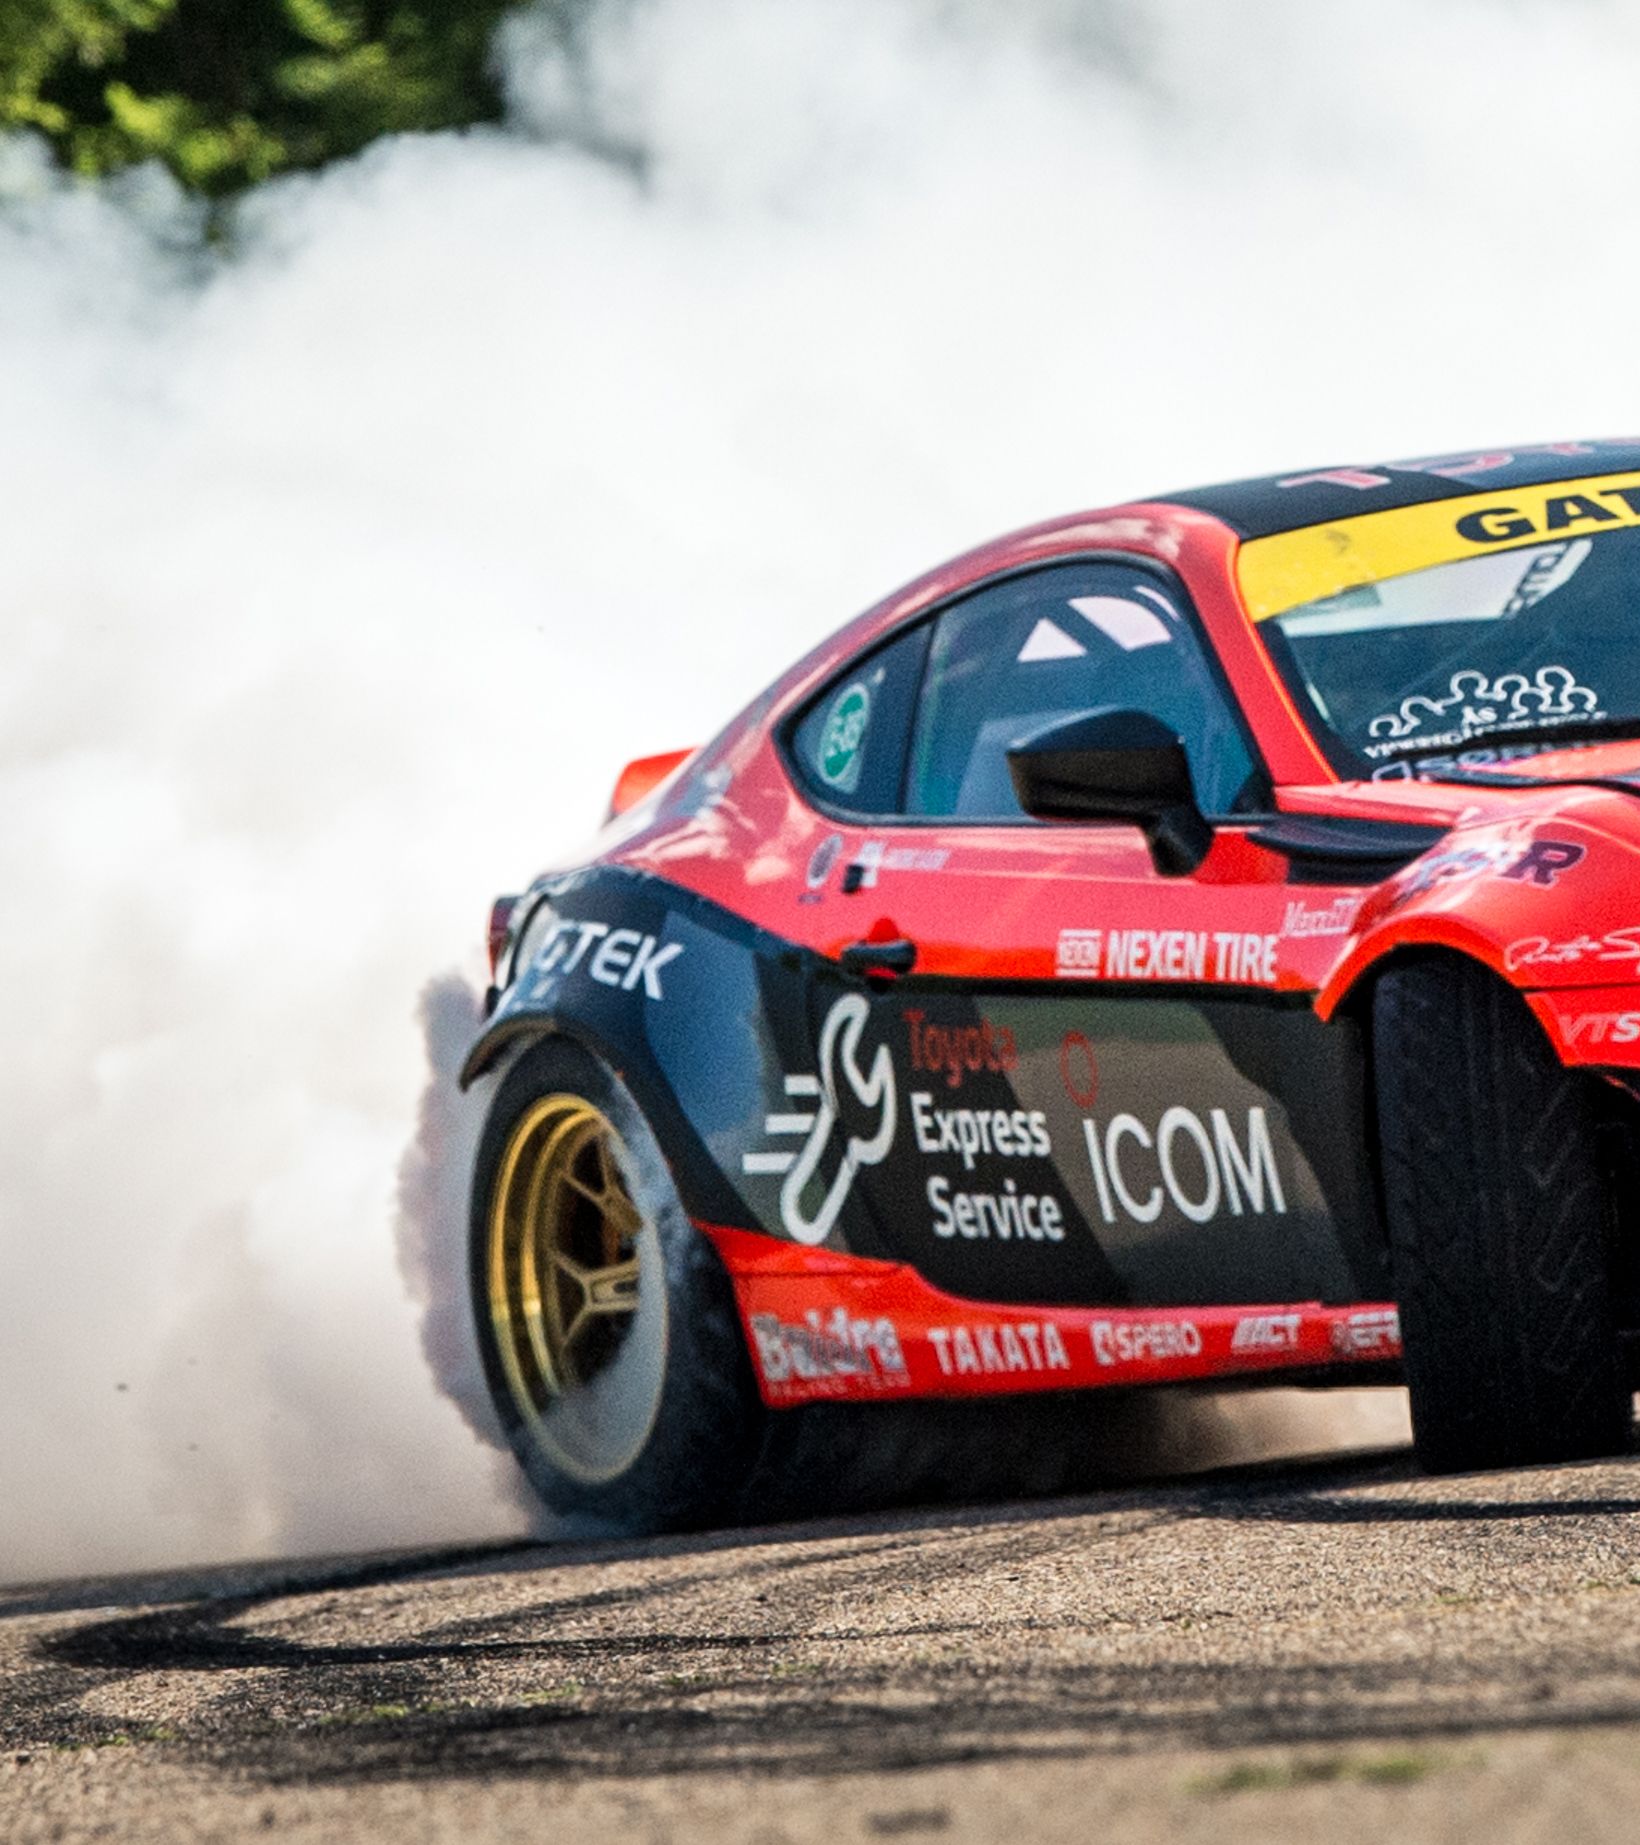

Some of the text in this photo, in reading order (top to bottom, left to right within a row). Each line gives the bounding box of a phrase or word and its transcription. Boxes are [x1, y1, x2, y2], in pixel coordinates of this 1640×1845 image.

[1107, 930, 1207, 978] NEXEN
[1214, 932, 1280, 983] TIRE
[903, 1008, 1018, 1088] Toyota
[910, 1092, 1052, 1170] Express
[1083, 1106, 1287, 1224] ICOM
[926, 1175, 1066, 1241] Service
[927, 1323, 1072, 1376] TAKATA
